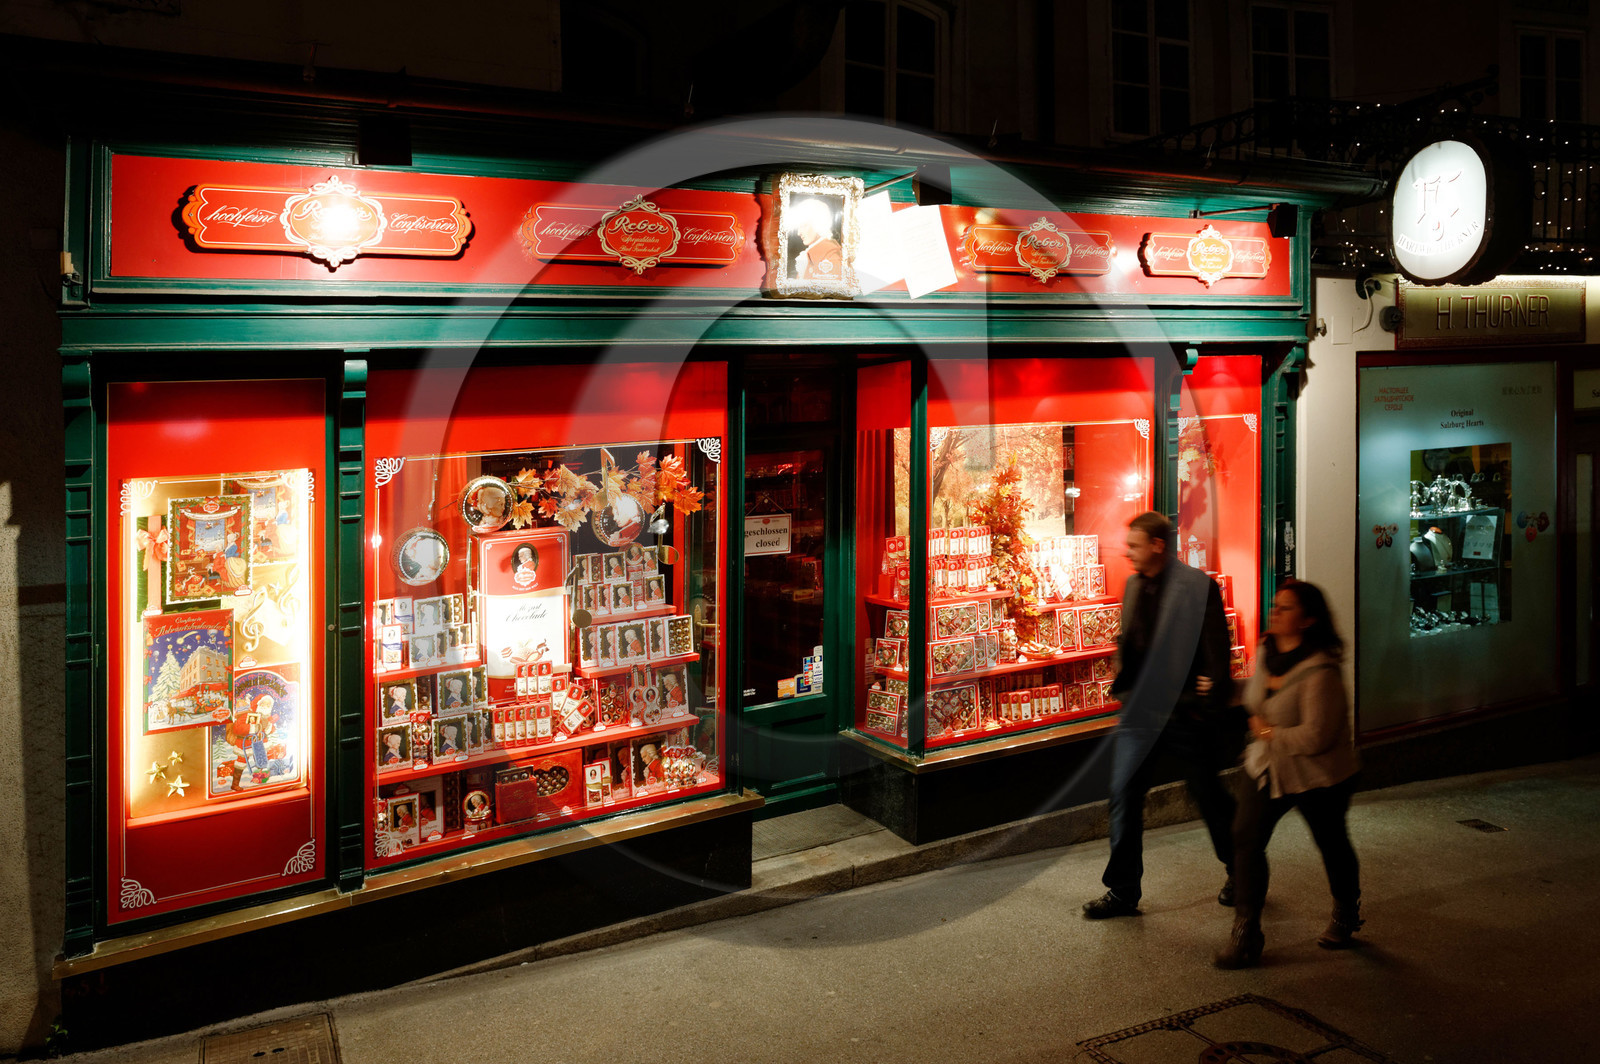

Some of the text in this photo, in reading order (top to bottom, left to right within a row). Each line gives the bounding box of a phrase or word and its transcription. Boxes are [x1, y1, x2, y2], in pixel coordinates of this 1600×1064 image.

[204, 204, 281, 228] hochfeine
[608, 215, 669, 236] Reber
[1021, 234, 1064, 251] Reber
[1461, 293, 1550, 330] THURNER
[1450, 408, 1474, 418] Original
[1440, 419, 1484, 430] Salzburg Hearts
[744, 527, 788, 538] geschlossen
[755, 537, 781, 548] closed
